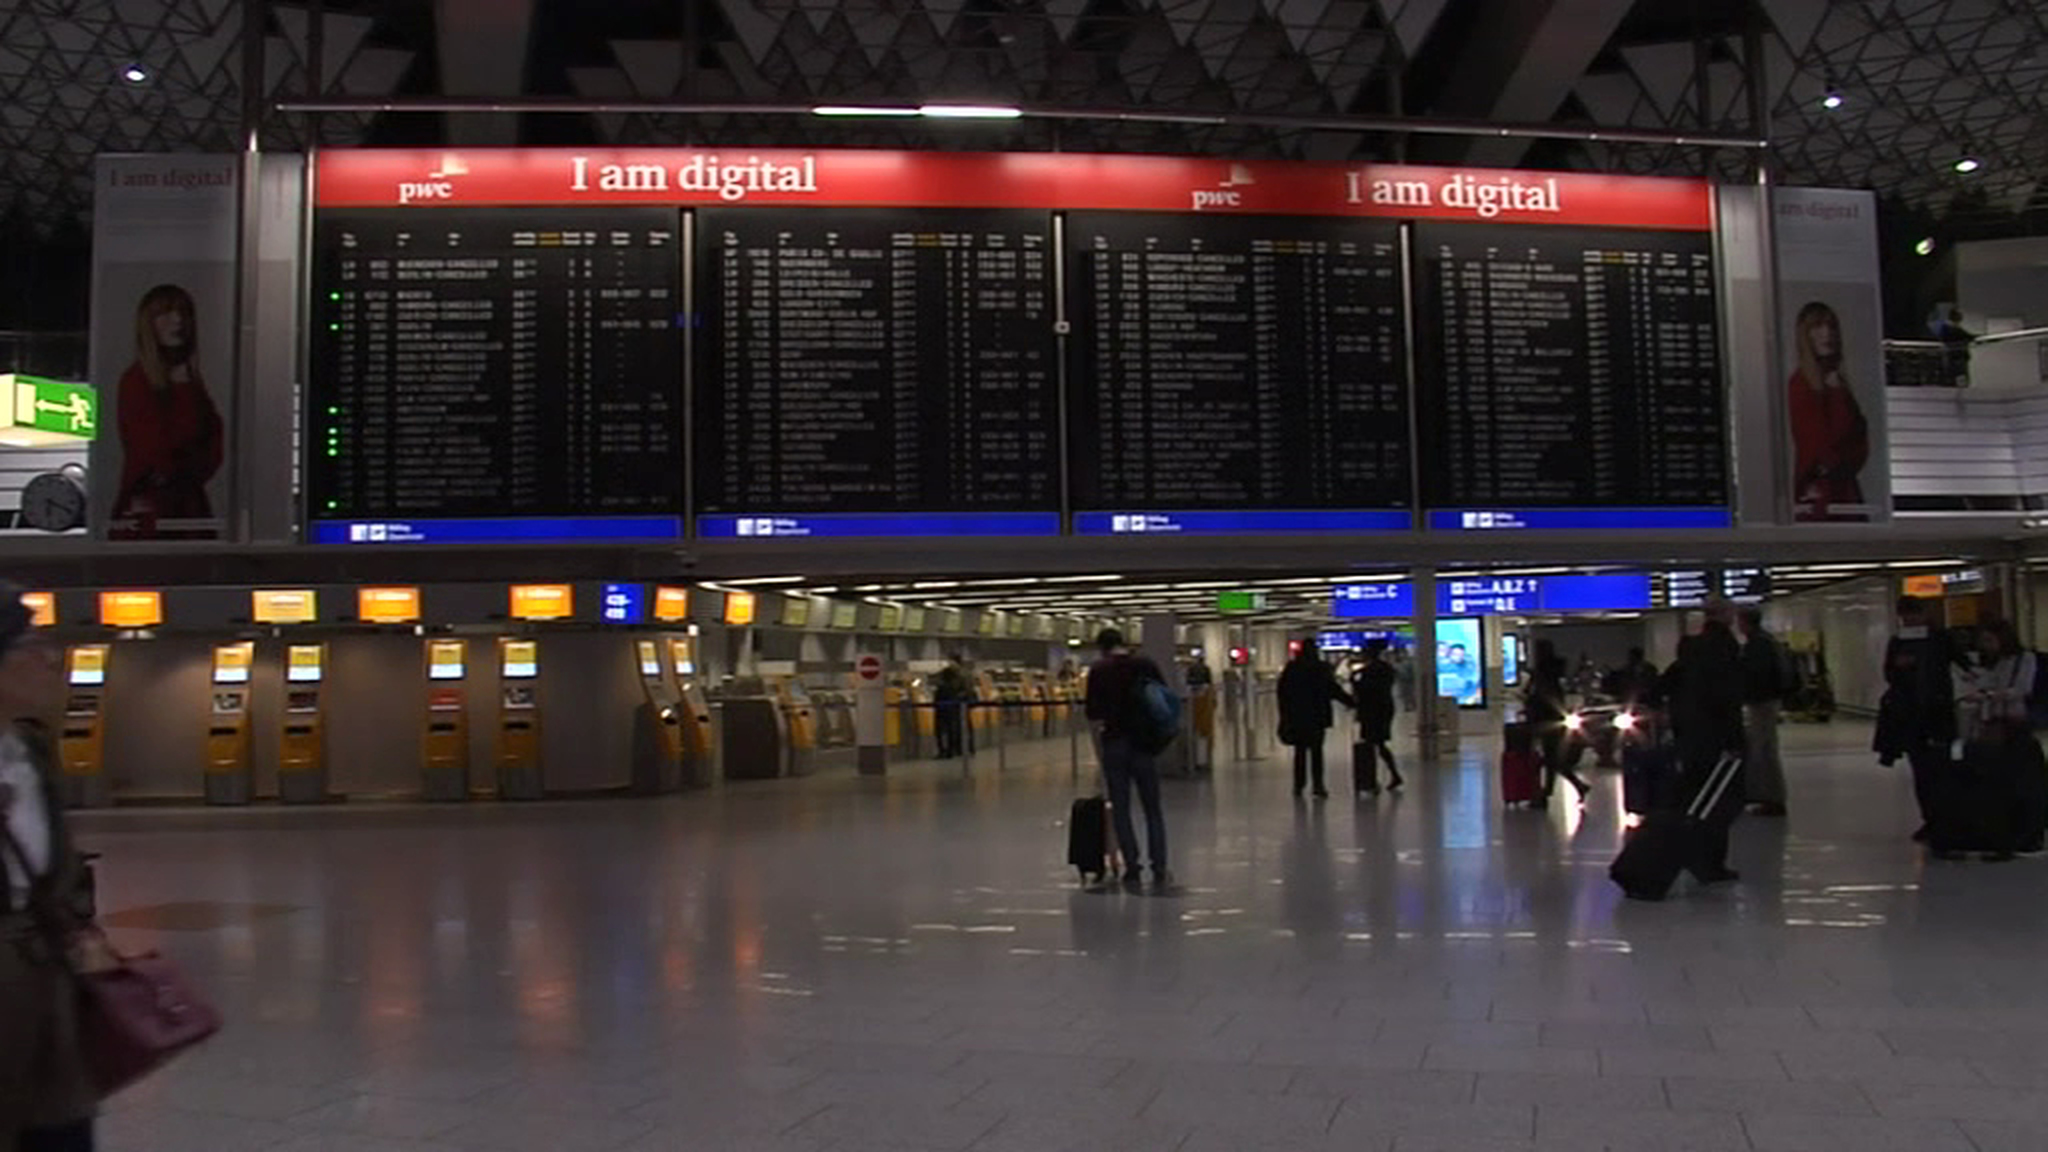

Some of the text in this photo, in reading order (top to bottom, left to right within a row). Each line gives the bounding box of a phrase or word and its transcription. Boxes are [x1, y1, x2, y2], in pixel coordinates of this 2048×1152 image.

[122, 173, 157, 187] am
[160, 168, 233, 189] digital
[571, 155, 817, 200] I am digital
[399, 181, 453, 203] pwc
[1192, 190, 1241, 210] pwc
[1347, 171, 1560, 217] I am digital
[1806, 201, 1859, 219] digital
